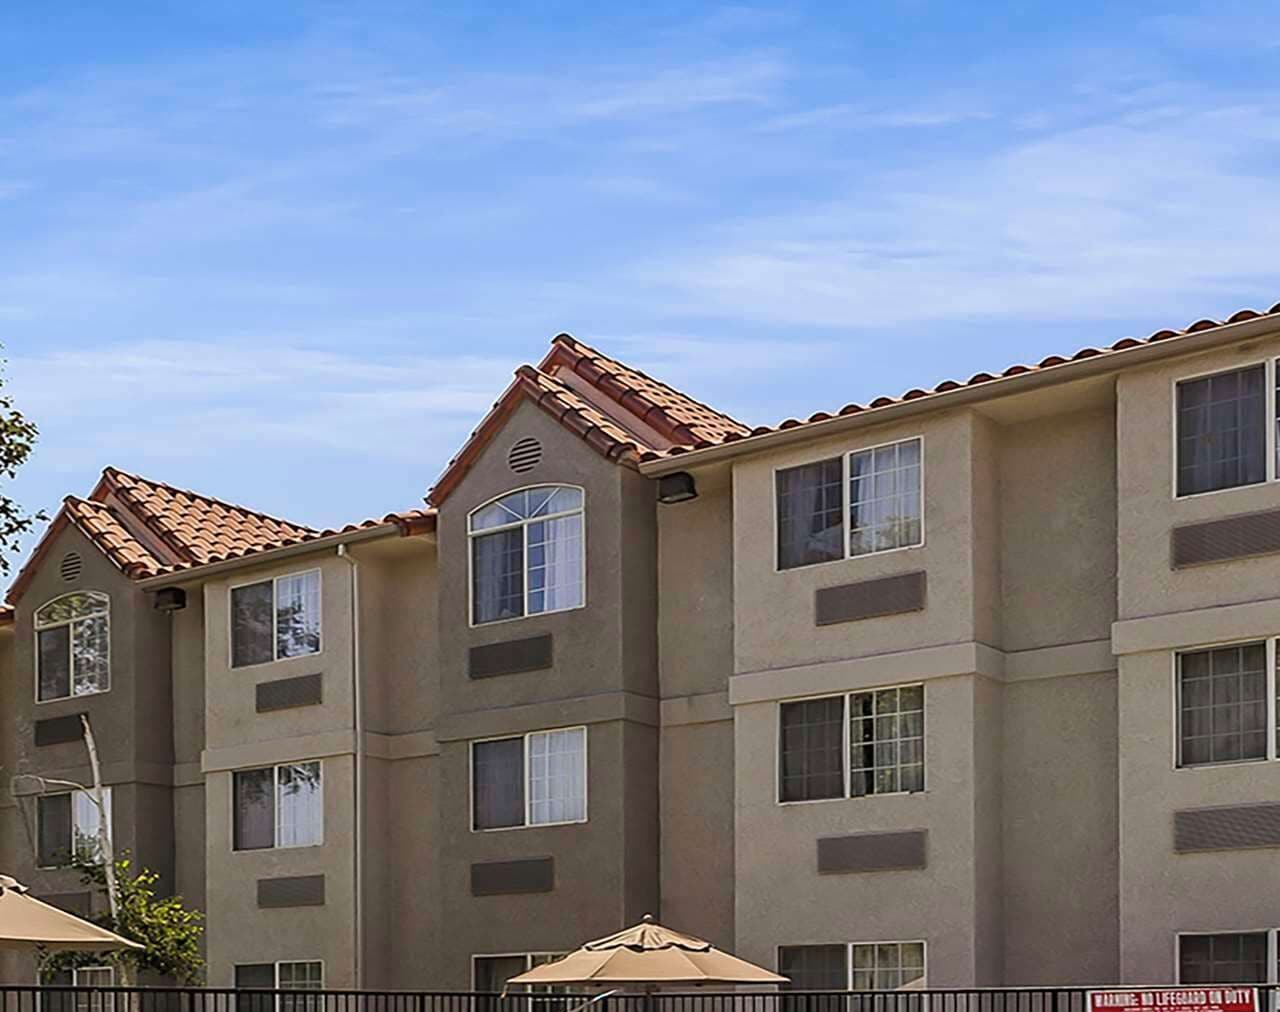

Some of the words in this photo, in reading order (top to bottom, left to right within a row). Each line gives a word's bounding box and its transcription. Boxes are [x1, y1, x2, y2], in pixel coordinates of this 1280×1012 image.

[1141, 992, 1153, 1006] NO
[1156, 990, 1207, 1006] LIFEGUARD
[1209, 990, 1222, 1005] ON
[1224, 989, 1251, 1004] DUTY
